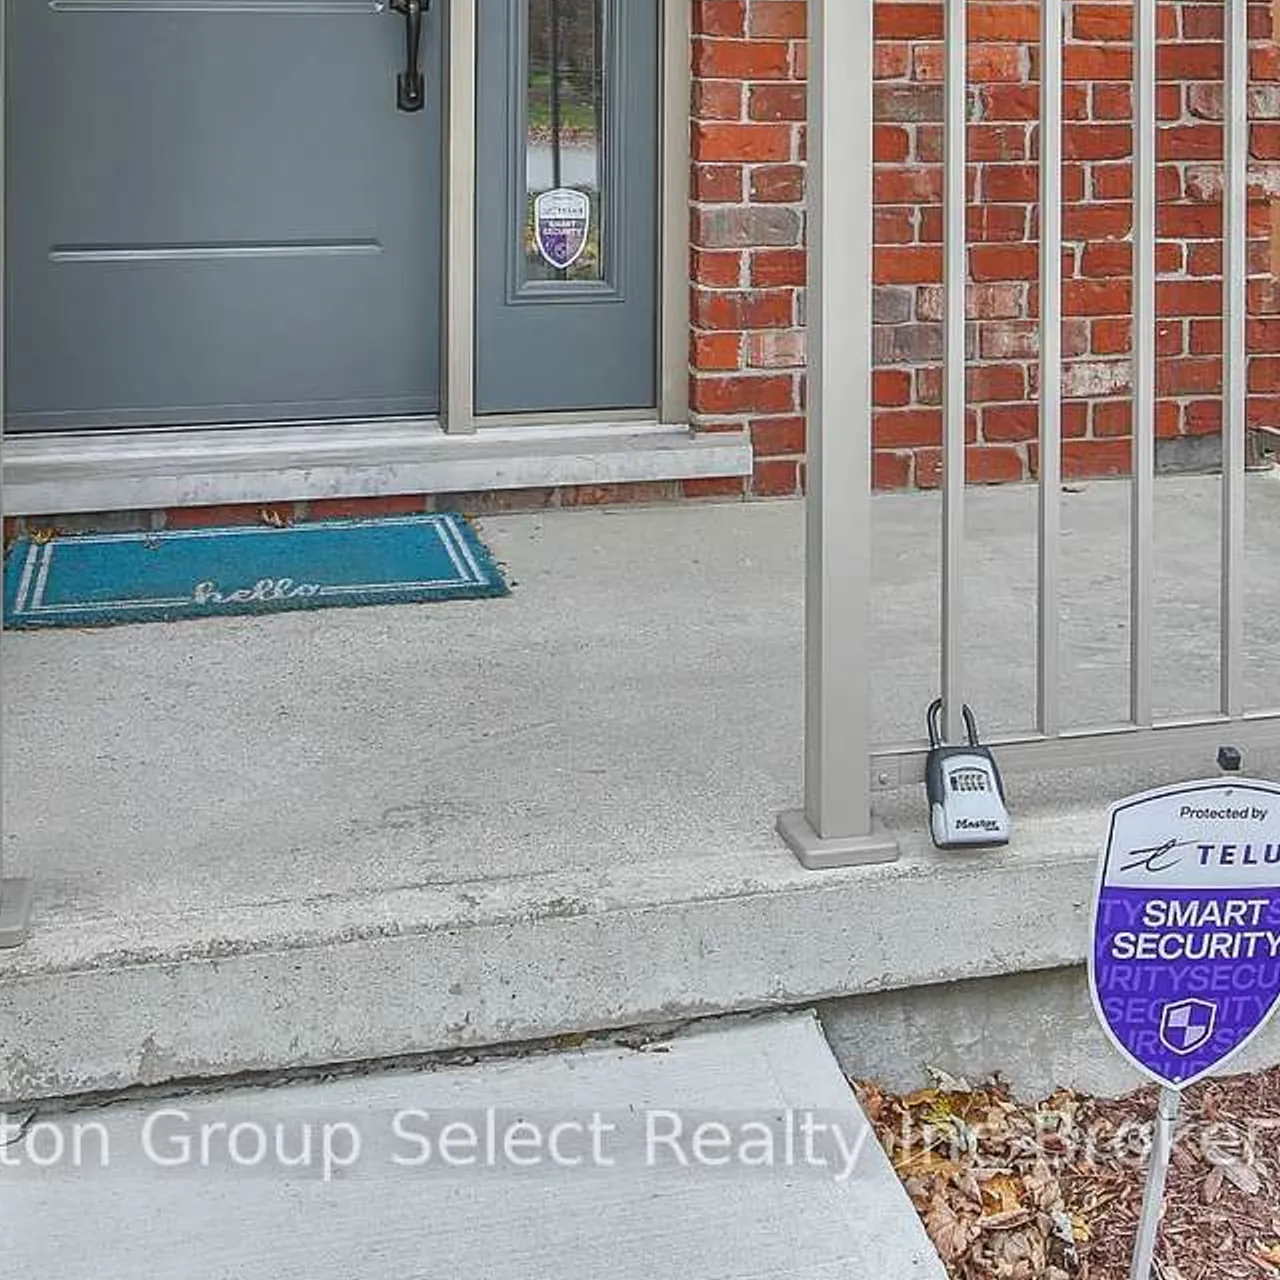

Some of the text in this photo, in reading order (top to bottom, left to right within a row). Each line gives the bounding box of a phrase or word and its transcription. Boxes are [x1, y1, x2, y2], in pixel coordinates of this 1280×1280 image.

[193, 577, 322, 604] hello
[1179, 805, 1269, 821] Protected by
[1142, 899, 1269, 928] SMART
